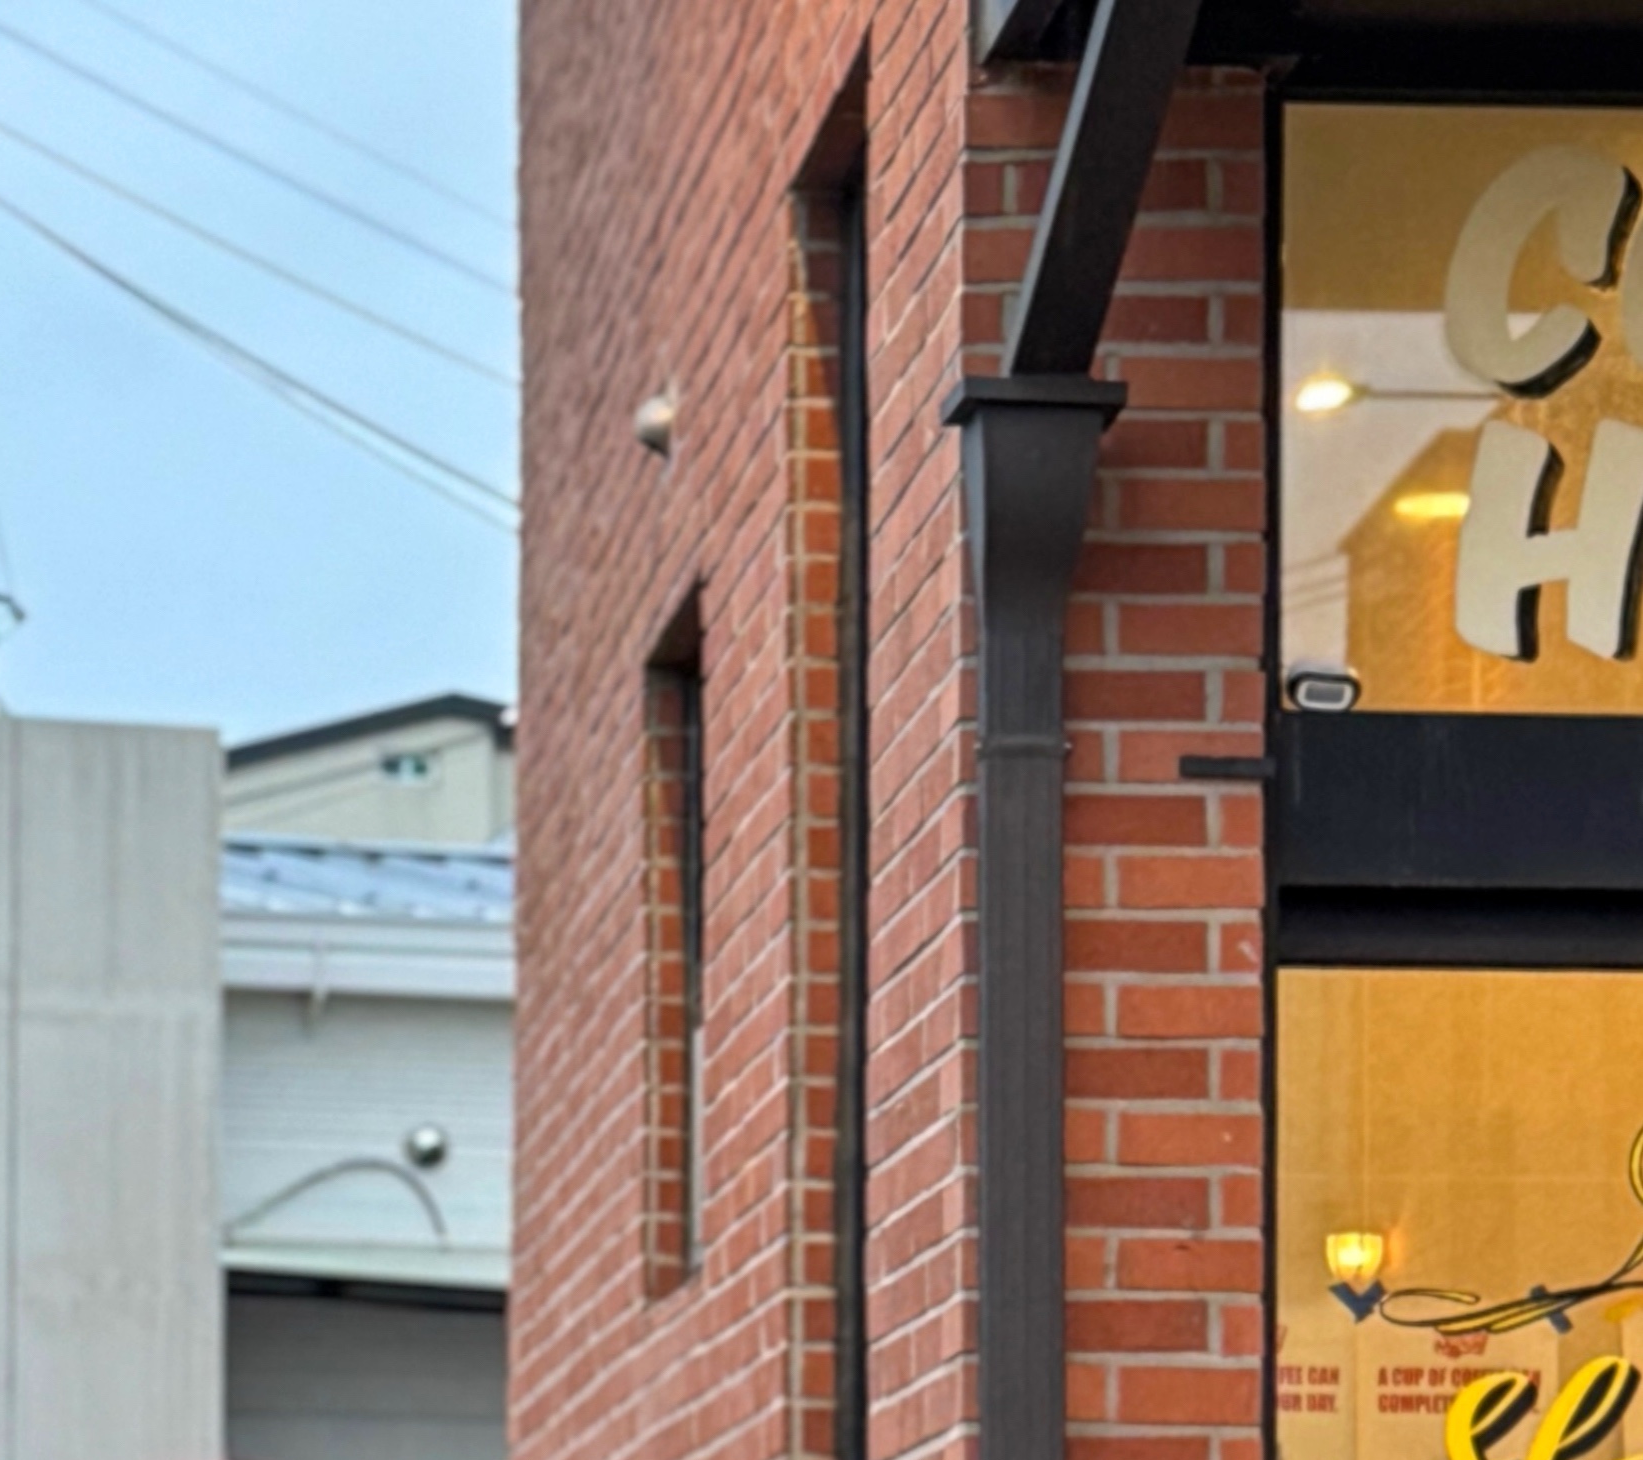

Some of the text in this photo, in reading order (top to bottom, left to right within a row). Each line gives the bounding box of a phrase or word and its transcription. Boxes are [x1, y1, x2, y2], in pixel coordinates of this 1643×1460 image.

[1444, 143, 1643, 398] C
[1392, 1367, 1424, 1387] CUP
[1428, 1367, 1447, 1387] OF
[1378, 1393, 1454, 1414] COMPLE
